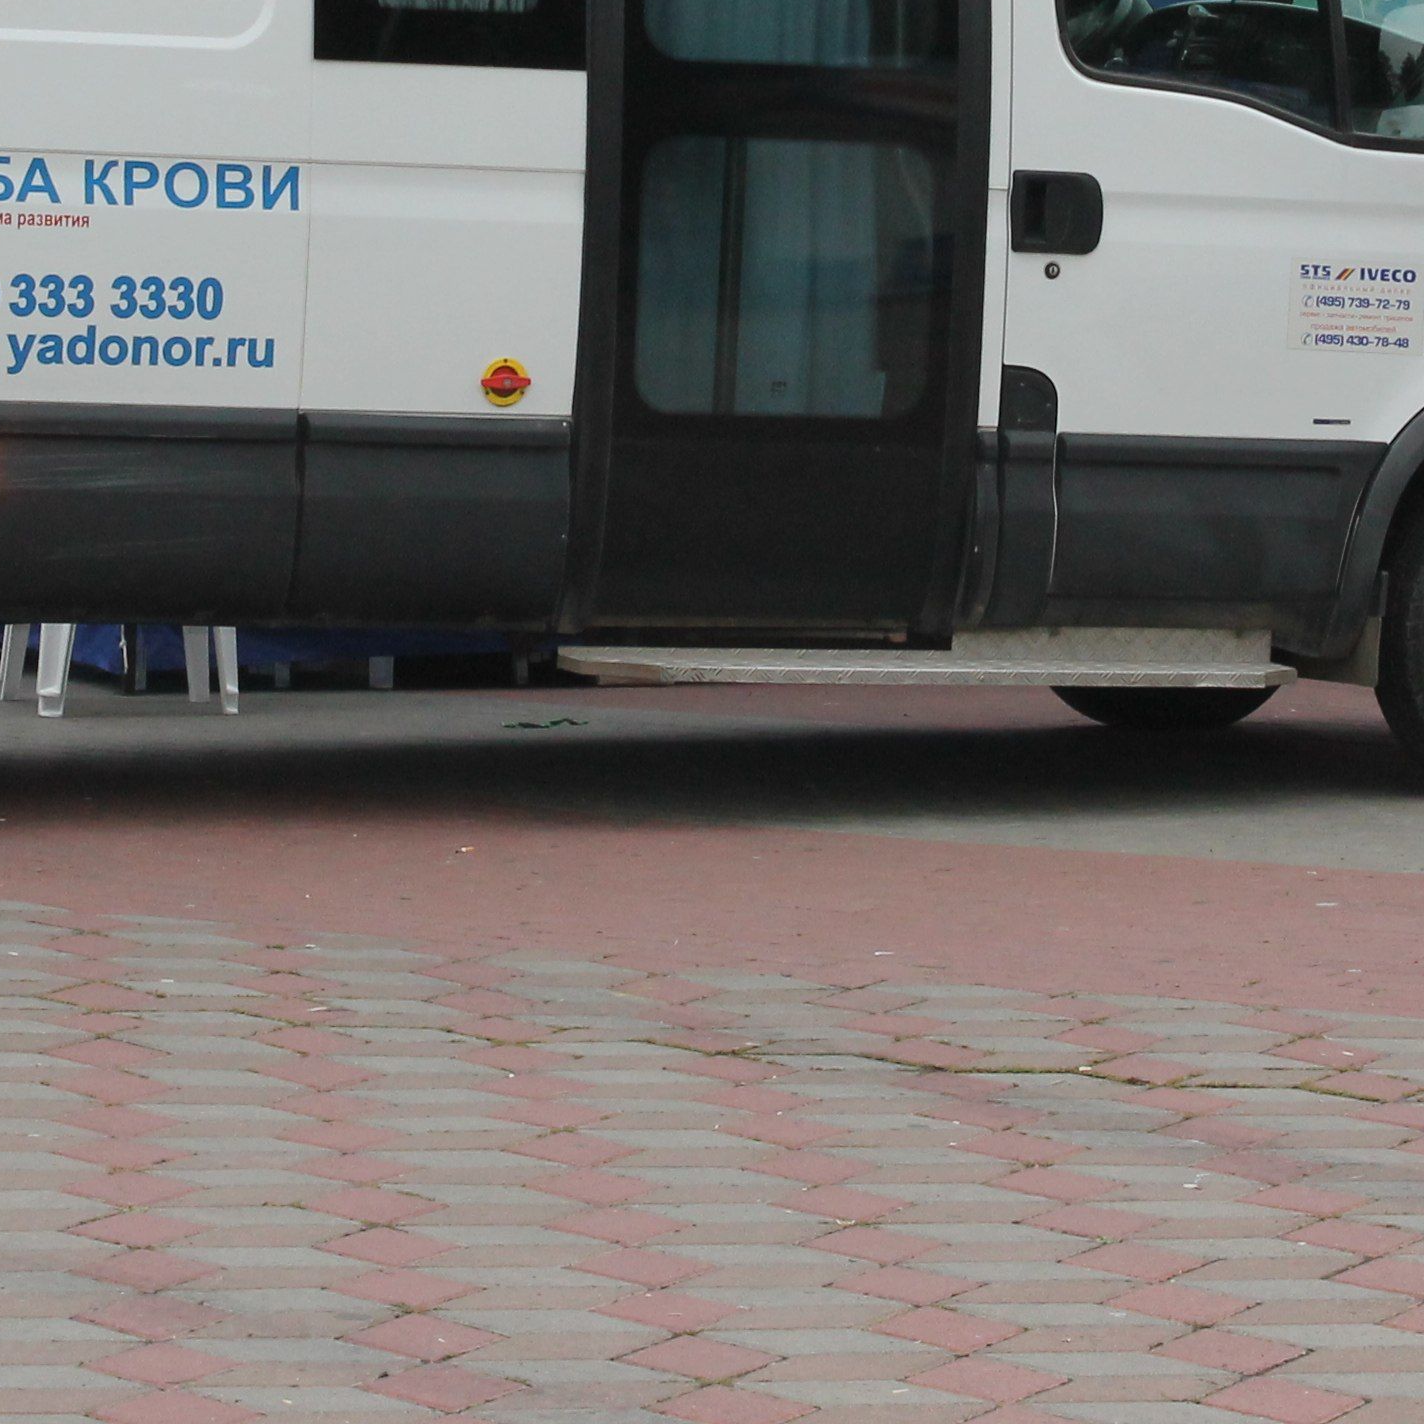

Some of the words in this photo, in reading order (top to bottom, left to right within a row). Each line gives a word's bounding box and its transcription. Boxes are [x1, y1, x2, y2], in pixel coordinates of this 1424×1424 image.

[83, 159, 301, 212] КРОВИ
[17, 213, 90, 230] развития
[1300, 264, 1331, 276] STS
[1359, 267, 1417, 283] IVECO
[9, 273, 95, 319] 333
[110, 276, 224, 320] 3330
[1315, 295, 1345, 308] (495)
[1348, 297, 1410, 310] 739-72-79
[1314, 334, 1344, 347] (495)
[1346, 335, 1409, 349] 430-78-48
